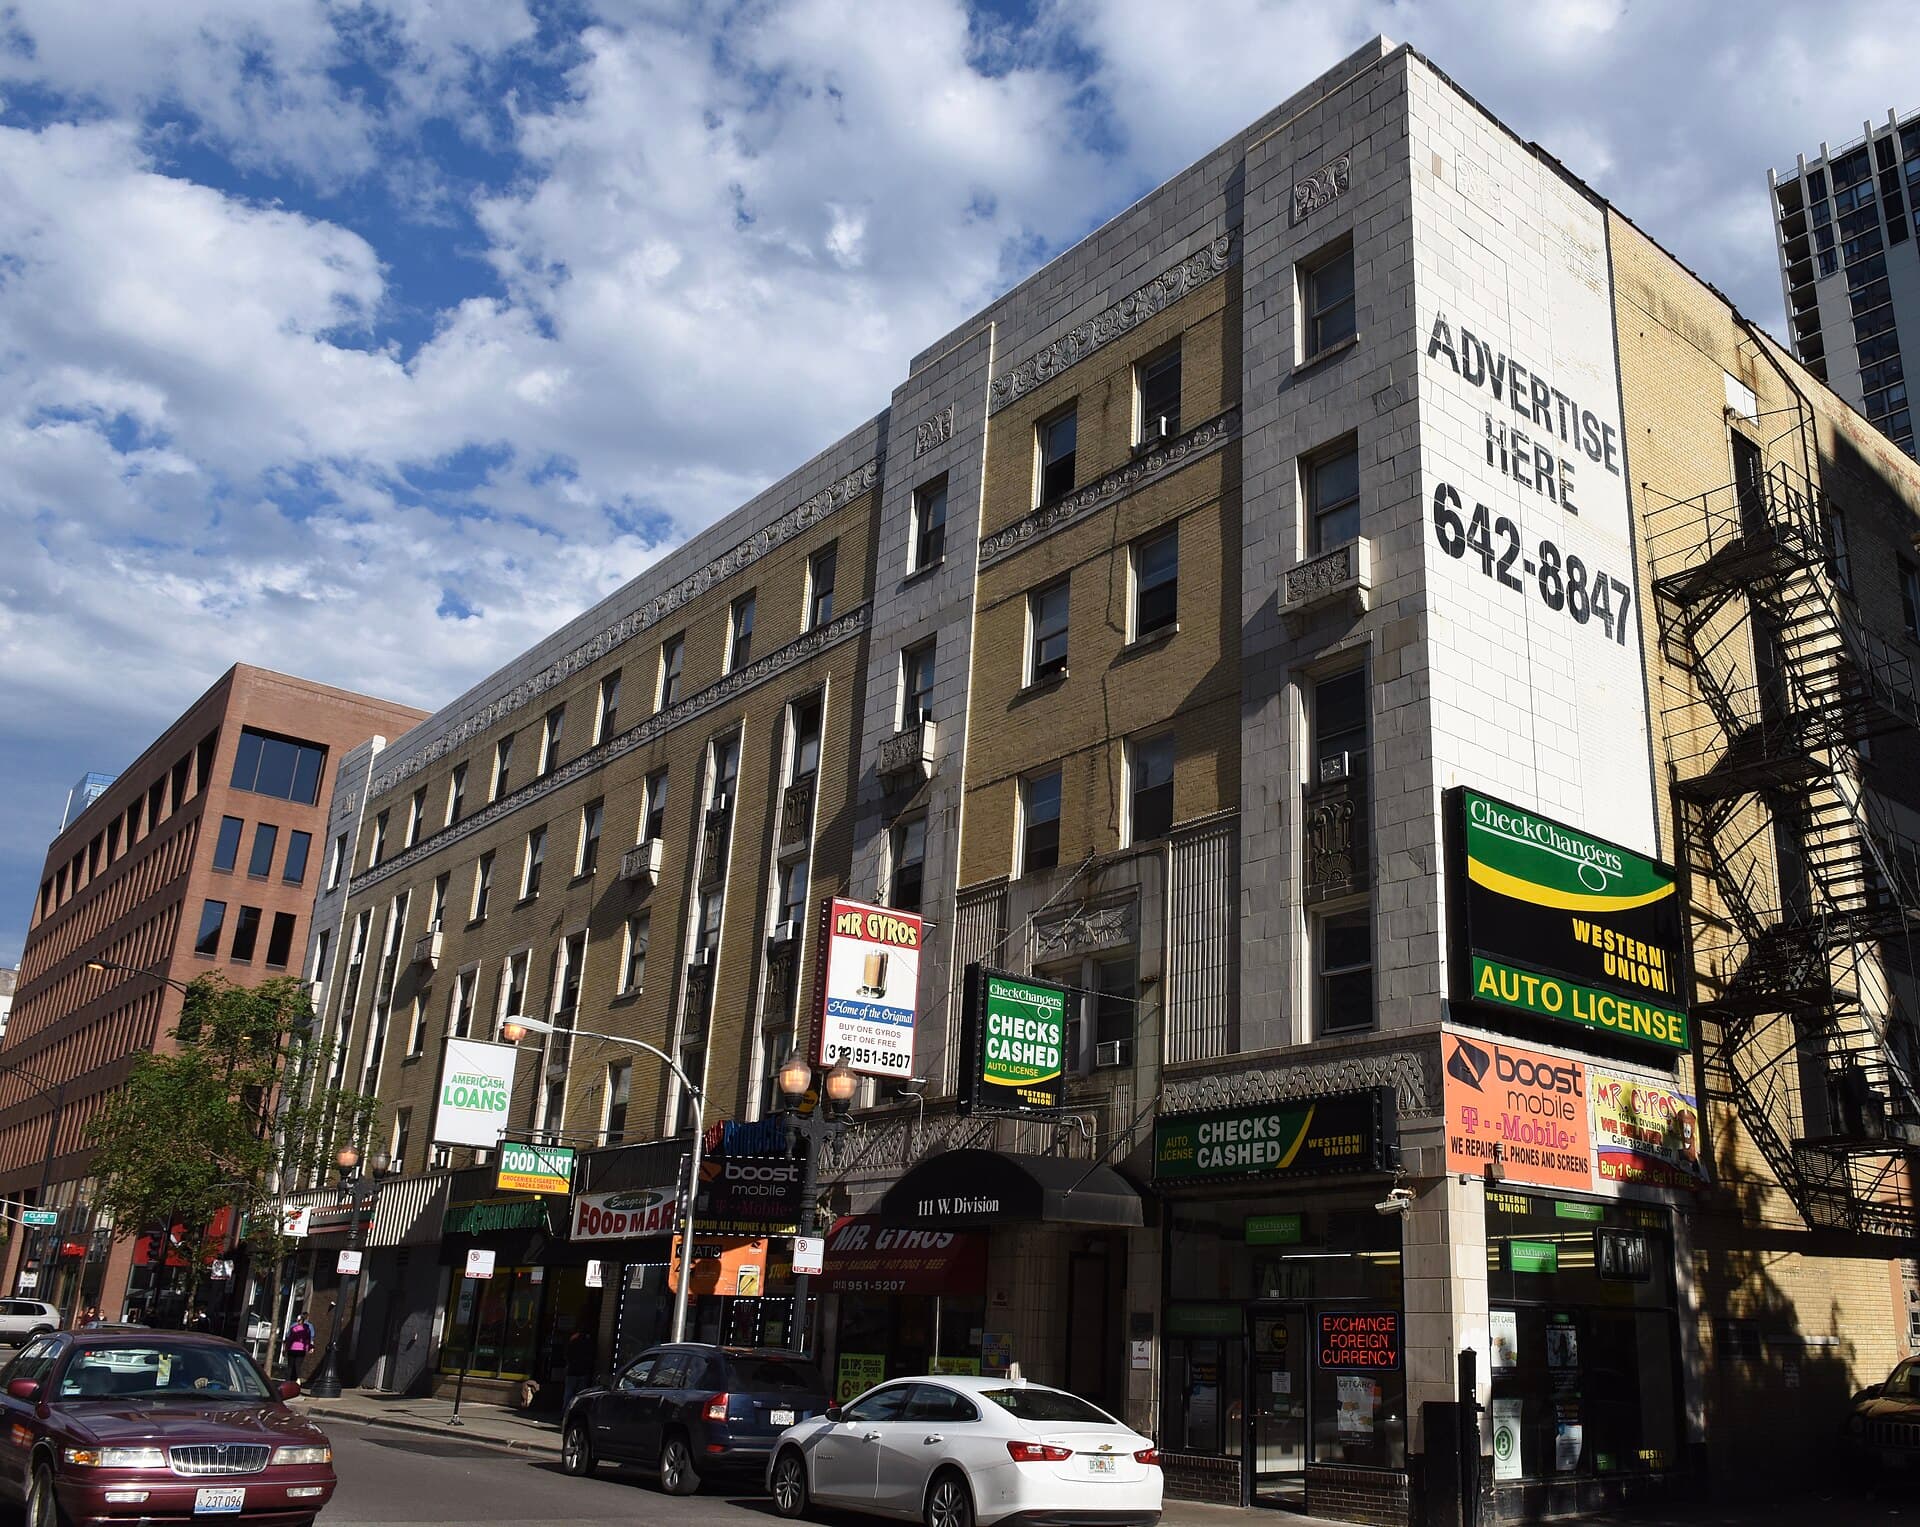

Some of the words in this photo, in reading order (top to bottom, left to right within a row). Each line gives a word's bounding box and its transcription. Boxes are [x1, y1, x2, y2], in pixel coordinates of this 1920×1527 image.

[1427, 309, 1620, 477] ADVERTISE
[1485, 411, 1579, 517] HERE
[1433, 482, 1631, 647] 642-8847
[1470, 800, 1622, 871] CheckChangers
[837, 912, 864, 939] MR
[866, 913, 918, 946] GYROS
[1572, 918, 1662, 969] WESTERN
[1603, 952, 1664, 992] UNION
[989, 983, 1062, 1008] CheckChangers
[1478, 965, 1563, 1012] AUTO
[1572, 989, 1684, 1044] LICENSE
[827, 1000, 858, 1016] Home
[859, 1005, 867, 1020] of
[868, 1007, 881, 1019] the
[881, 1008, 914, 1025] Original
[839, 1022, 855, 1032] BUY
[856, 1025, 874, 1035] ONE
[875, 1028, 902, 1039] GYROS
[841, 1033, 858, 1043] GET
[858, 1035, 876, 1045] ONE
[877, 1038, 897, 1048] FREE
[988, 1013, 1060, 1045] CHECKS
[987, 1037, 1059, 1069] CASHED
[987, 1061, 1007, 1072] AUTO
[1009, 1065, 1039, 1077] LICENSE
[1494, 1046, 1583, 1097] boost
[443, 1085, 507, 1112] LOANS
[1016, 1088, 1051, 1099] WESTERN
[1027, 1096, 1051, 1106] UNION
[1507, 1089, 1576, 1121] mobile
[1597, 1081, 1629, 1112] MR.
[1198, 1115, 1281, 1145] CHECKS
[1600, 1116, 1618, 1134] WE
[1620, 1122, 1663, 1146] DELIVER
[1639, 1118, 1666, 1132] DIVISION
[1166, 1135, 1188, 1148] AUTO
[1308, 1134, 1360, 1148] WESTERN
[1323, 1145, 1360, 1157] UNION
[502, 1150, 535, 1172] FOOD
[537, 1154, 571, 1175] MART
[1159, 1148, 1193, 1161] LICENSE
[1197, 1140, 1281, 1169] CASHED
[1450, 1136, 1463, 1154] WE
[1465, 1138, 1494, 1159] REPAIR
[1510, 1146, 1540, 1166] PHONES
[1541, 1152, 1555, 1169] AND
[1556, 1154, 1589, 1174] SCREENS
[725, 1161, 799, 1182] boost
[1601, 1160, 1616, 1178] Buy
[1617, 1163, 1623, 1176] 1
[1625, 1164, 1647, 1181] Gyros
[731, 1184, 786, 1197] mobile
[1486, 1192, 1526, 1204] WESTERN
[577, 1201, 627, 1235] FOOD
[629, 1199, 677, 1233] MAR
[918, 1200, 934, 1216] 111
[937, 1198, 950, 1215] W.
[953, 1196, 1000, 1214] Division
[1498, 1203, 1527, 1214] UNION
[831, 1225, 871, 1250] MR.
[1323, 1316, 1396, 1332] EXCHANGE
[1330, 1334, 1388, 1348] FOREIGN
[1322, 1349, 1396, 1366] CURRENCY
[206, 1495, 223, 1508] 237
[224, 1495, 242, 1508] 096
